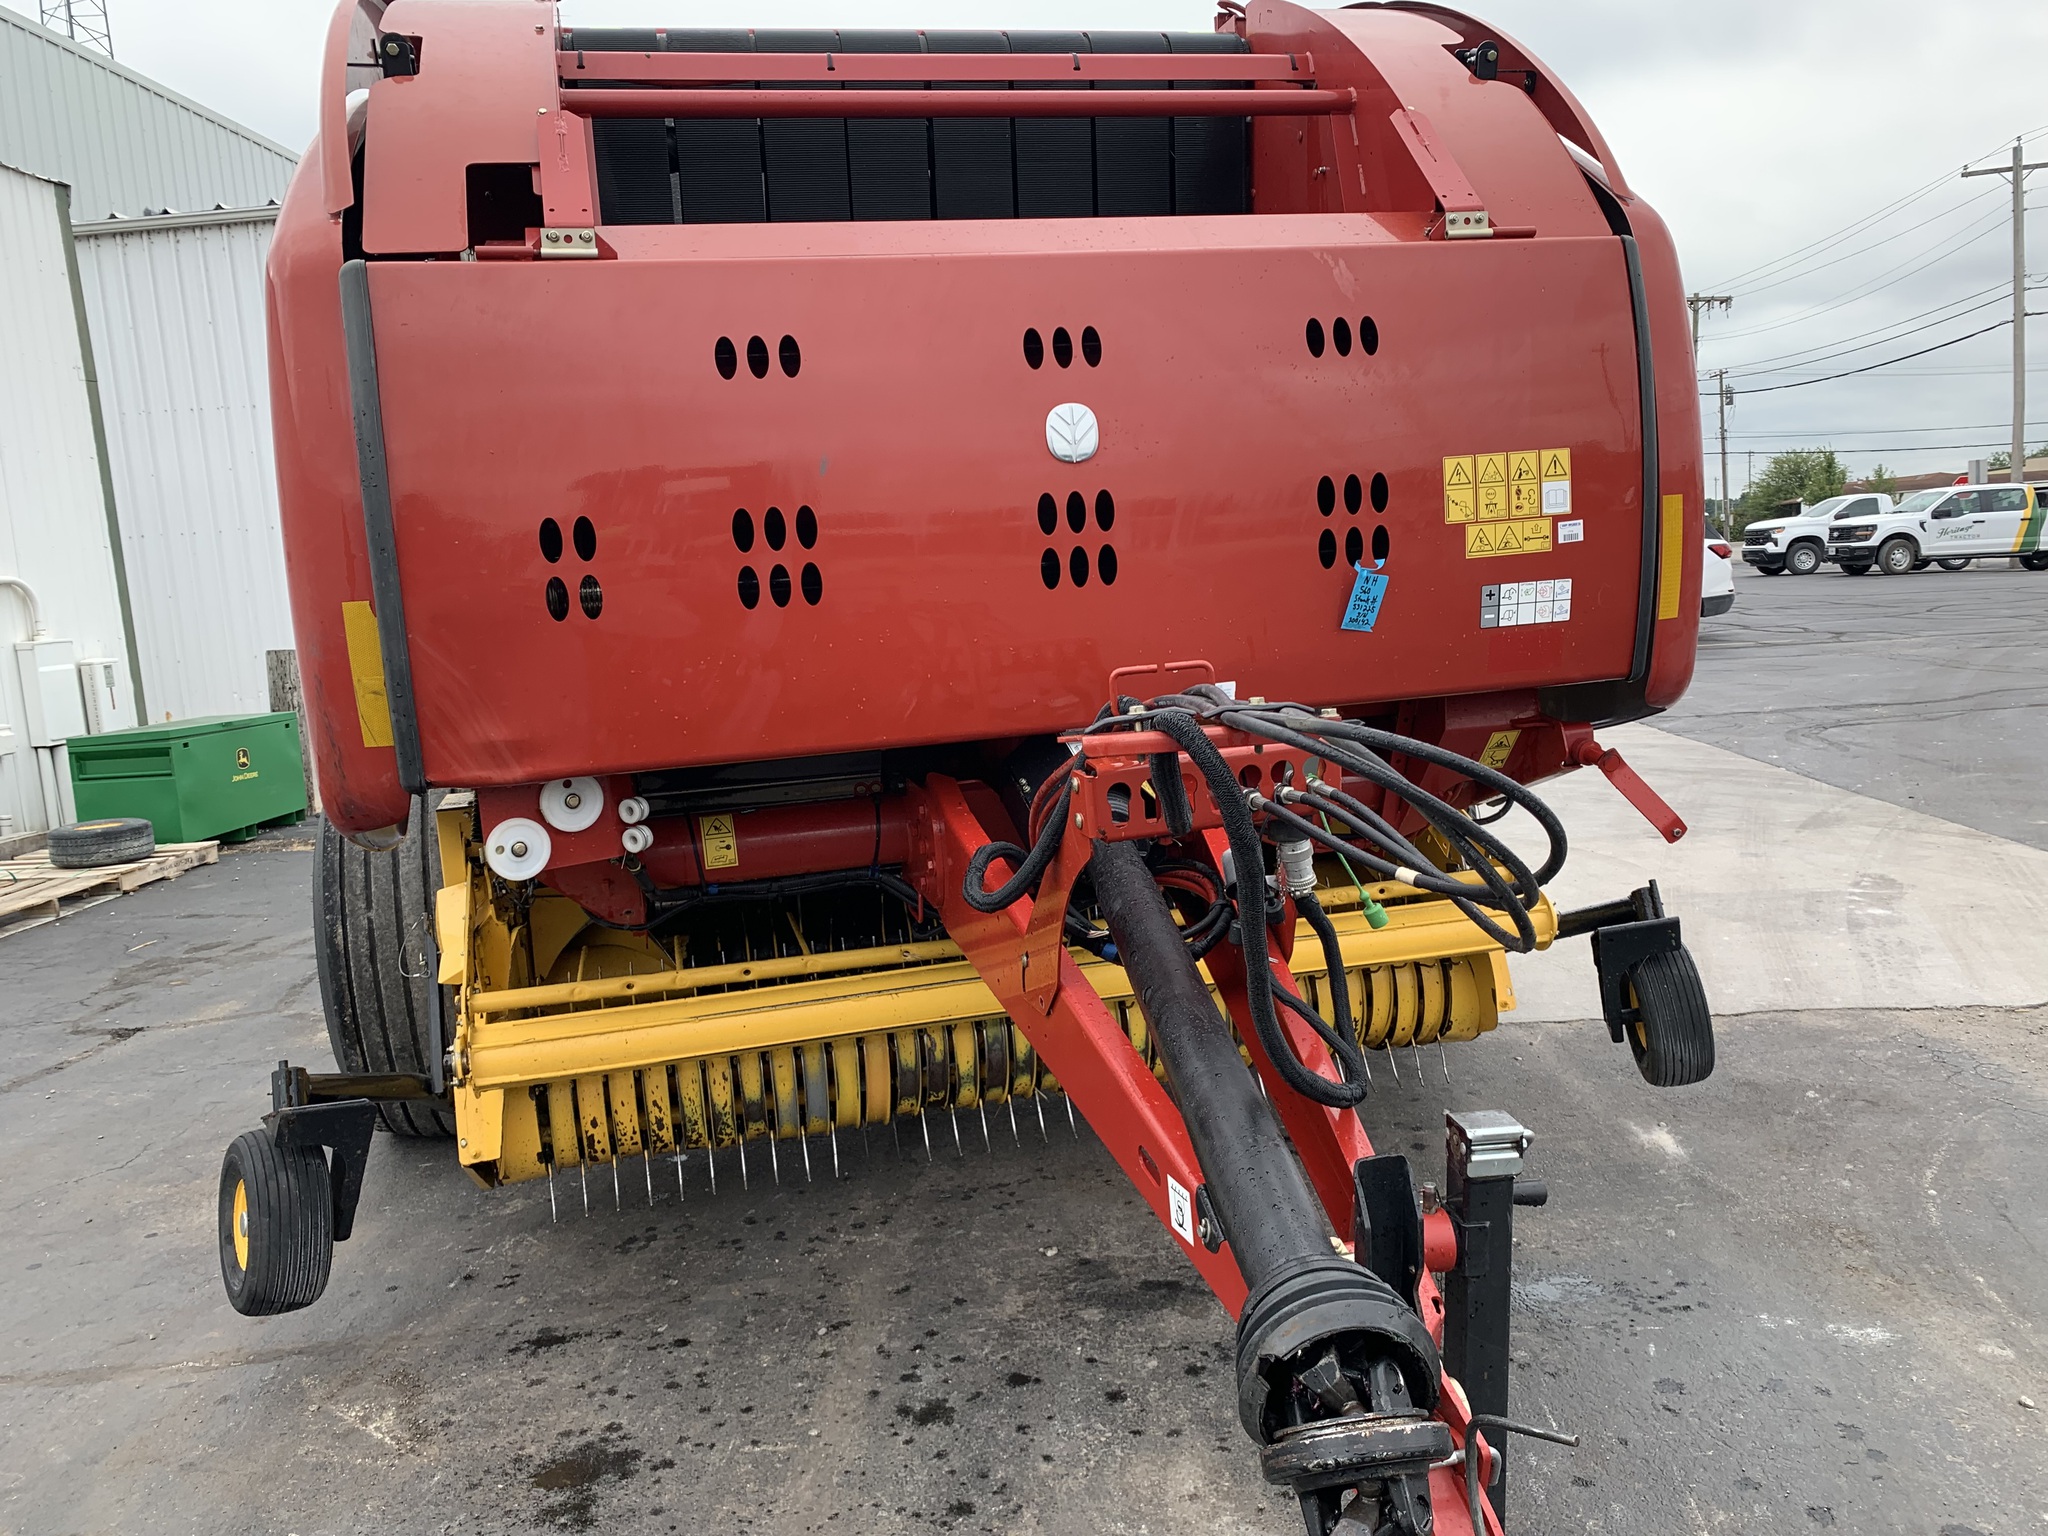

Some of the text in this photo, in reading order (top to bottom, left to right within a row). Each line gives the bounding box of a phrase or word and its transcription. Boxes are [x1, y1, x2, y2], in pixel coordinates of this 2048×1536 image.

[1936, 524, 1975, 539] Heritage
[1359, 585, 1371, 595] 560
[244, 771, 258, 779] DEERE
